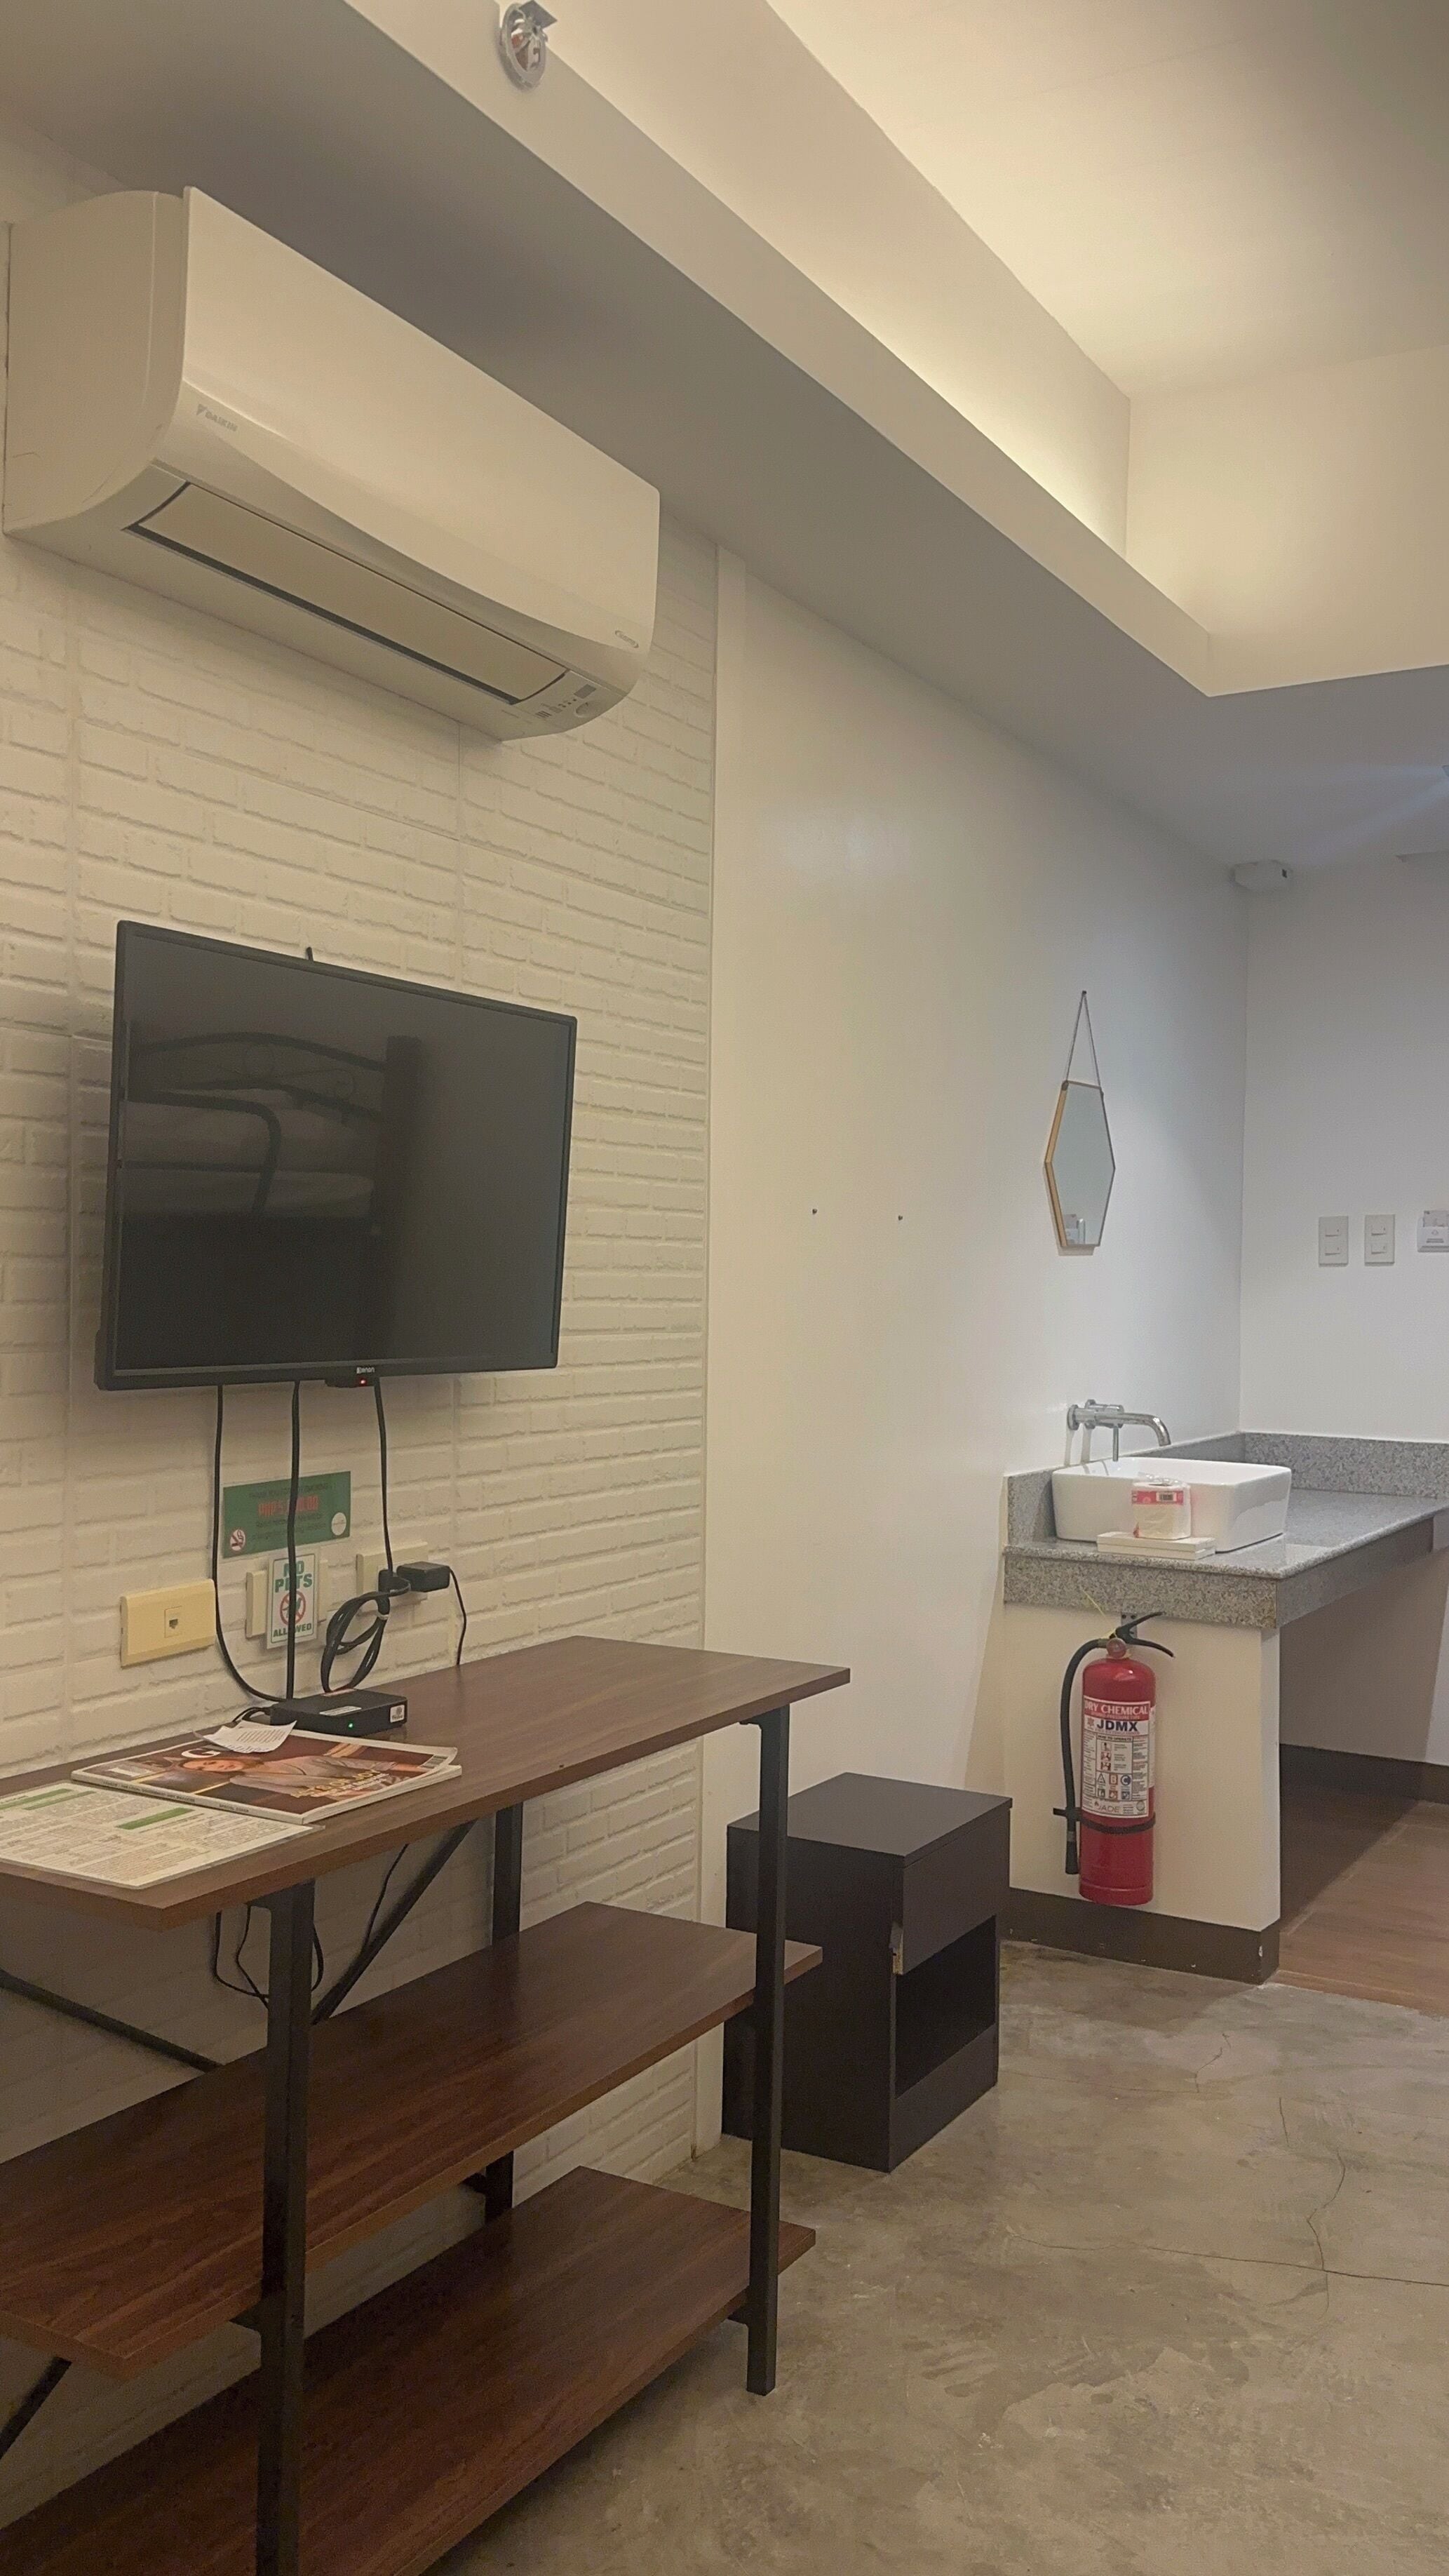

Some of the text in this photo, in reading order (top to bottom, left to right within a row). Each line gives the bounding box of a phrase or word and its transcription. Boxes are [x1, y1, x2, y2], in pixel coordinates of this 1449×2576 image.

[273, 1623, 312, 1637] ALLWED
[1084, 1700, 1149, 1715] DRY CHEMICAL
[1096, 1719, 1138, 1732] JDMX
